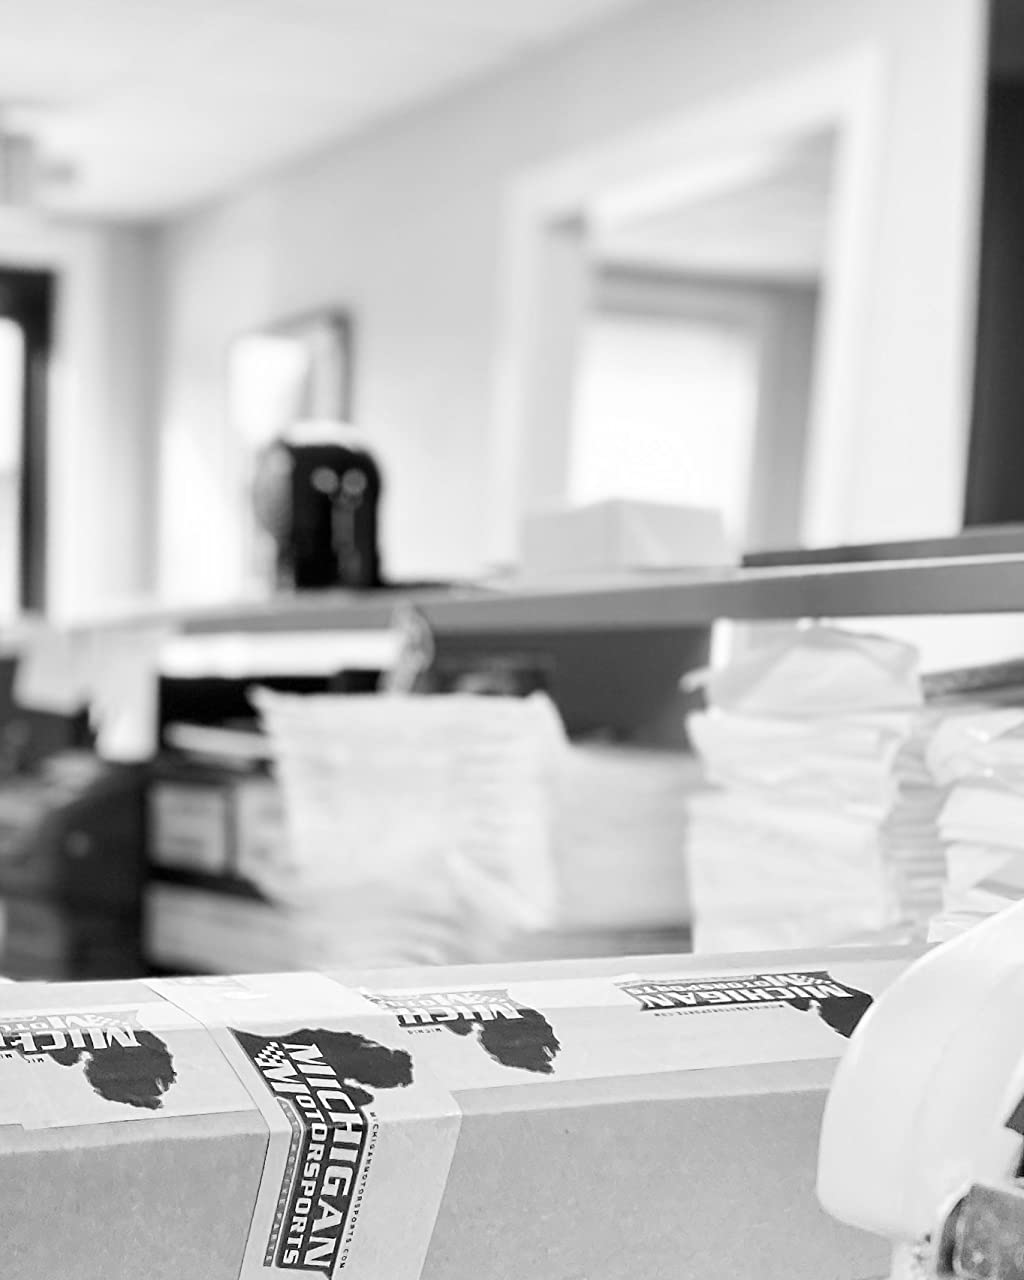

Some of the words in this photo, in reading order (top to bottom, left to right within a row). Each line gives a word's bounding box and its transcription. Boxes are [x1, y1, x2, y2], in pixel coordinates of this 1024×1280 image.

[626, 973, 805, 995] MOTORSPORTS
[635, 984, 853, 1009] MICHIGAN
[260, 1059, 328, 1265] MOTORSPORTS
[281, 1042, 364, 1268] MICHIGAN
